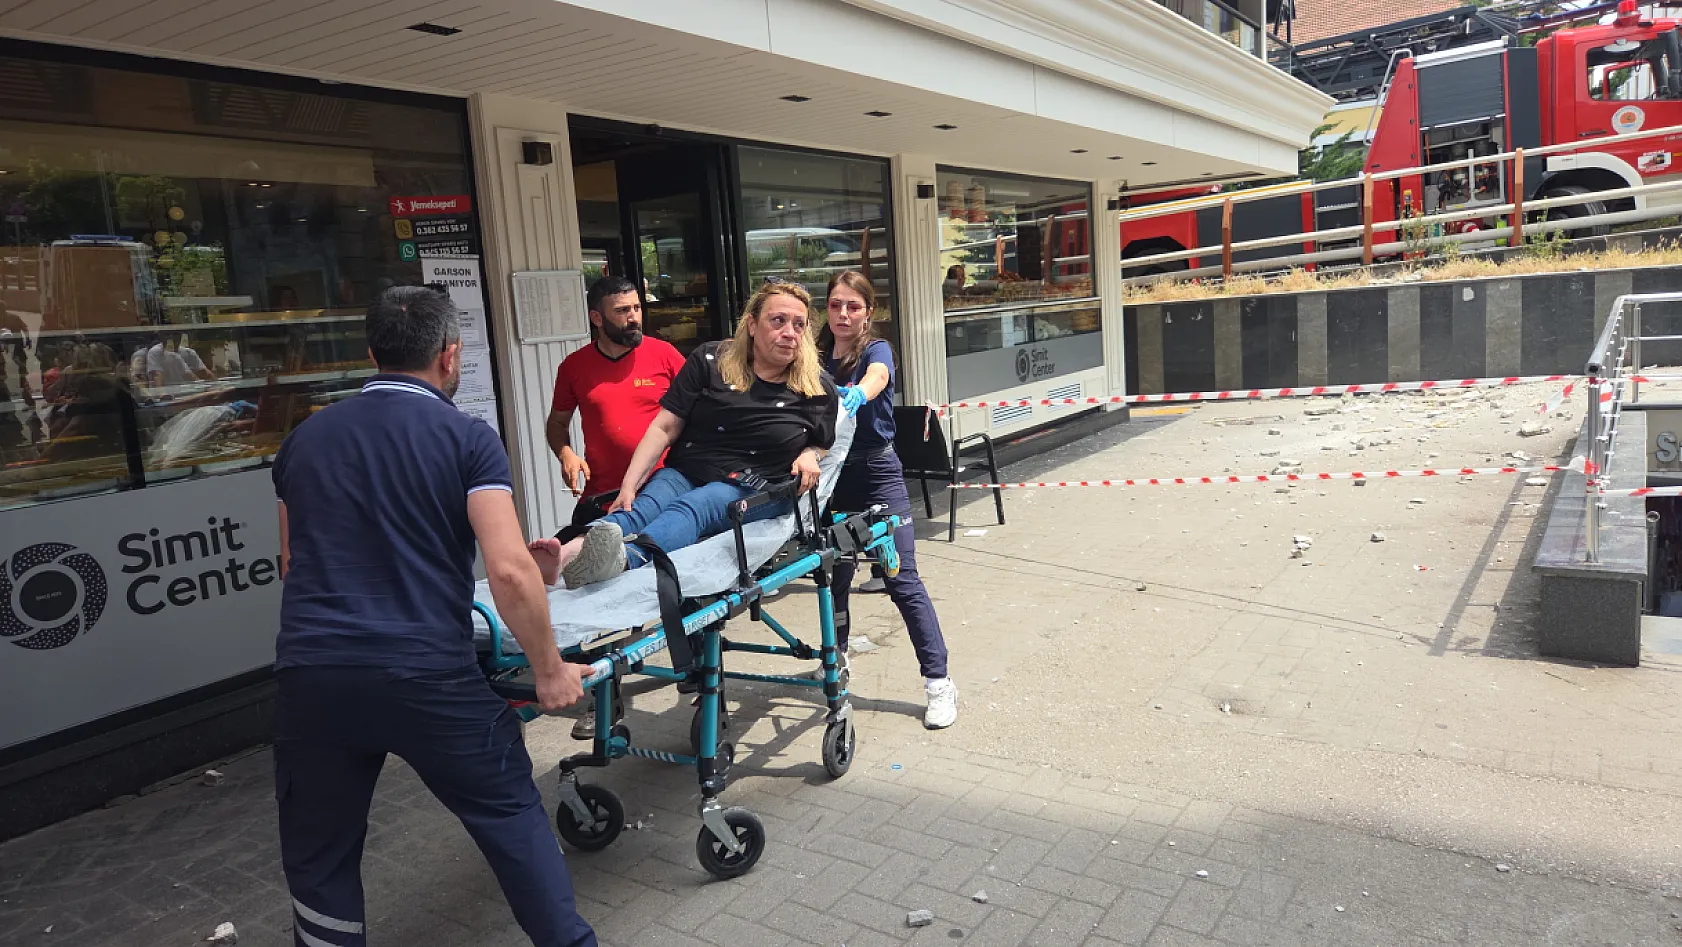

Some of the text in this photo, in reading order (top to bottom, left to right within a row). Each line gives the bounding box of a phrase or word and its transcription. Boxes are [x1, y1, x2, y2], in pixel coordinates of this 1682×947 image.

[411, 200, 457, 212] Yemeksepeti
[433, 267, 471, 276] GARSON
[1031, 348, 1049, 363] Simit
[1031, 362, 1055, 377] Center
[118, 516, 245, 574] Simit
